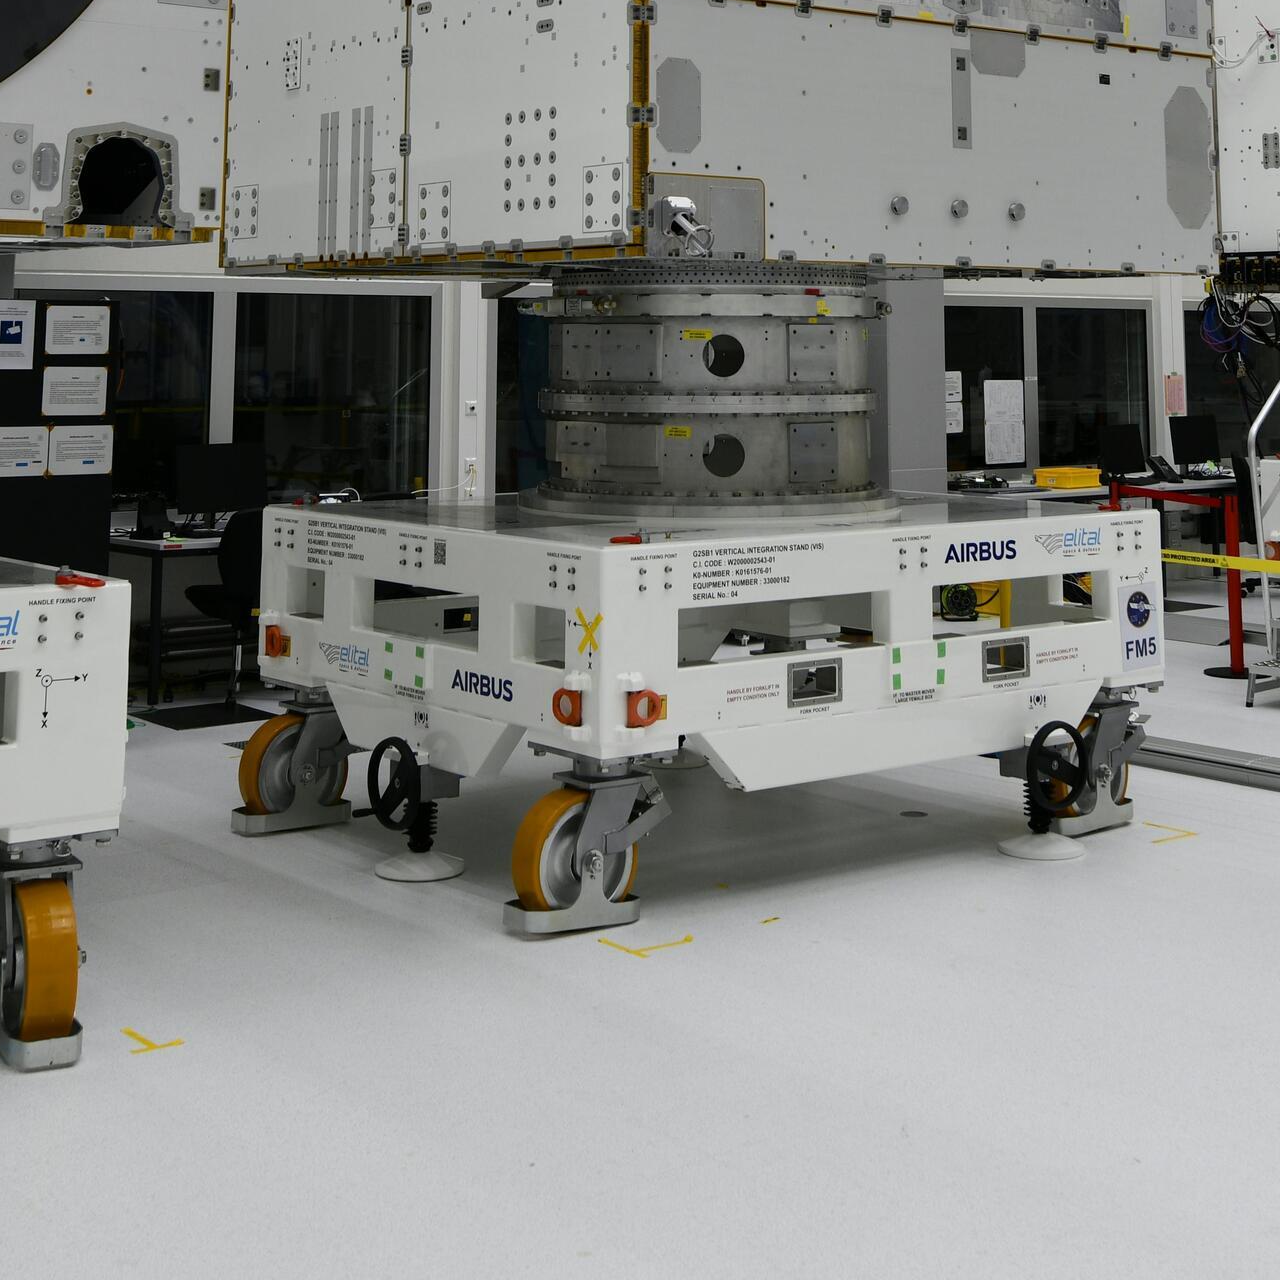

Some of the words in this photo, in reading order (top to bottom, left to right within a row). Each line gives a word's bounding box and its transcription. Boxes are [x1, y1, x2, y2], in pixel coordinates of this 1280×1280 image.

[1063, 527, 1101, 547] elital
[692, 549, 714, 558] G2SB1
[714, 547, 745, 556] VERTICAL
[746, 545, 788, 555] INTEGRATION
[789, 544, 809, 552] STAND
[810, 543, 824, 552] (VIS)
[944, 539, 1017, 564] AIRBUS
[704, 559, 722, 568] CODE
[692, 580, 731, 590] EQUIPMENT
[731, 579, 758, 588] NUMBER
[692, 592, 717, 601] SERIAL
[1125, 636, 1157, 660] FM5
[339, 644, 370, 667] elital
[35, 669, 42, 677] Z
[81, 673, 88, 682] Y
[451, 669, 513, 703] AIRBUS
[41, 720, 48, 729] X
